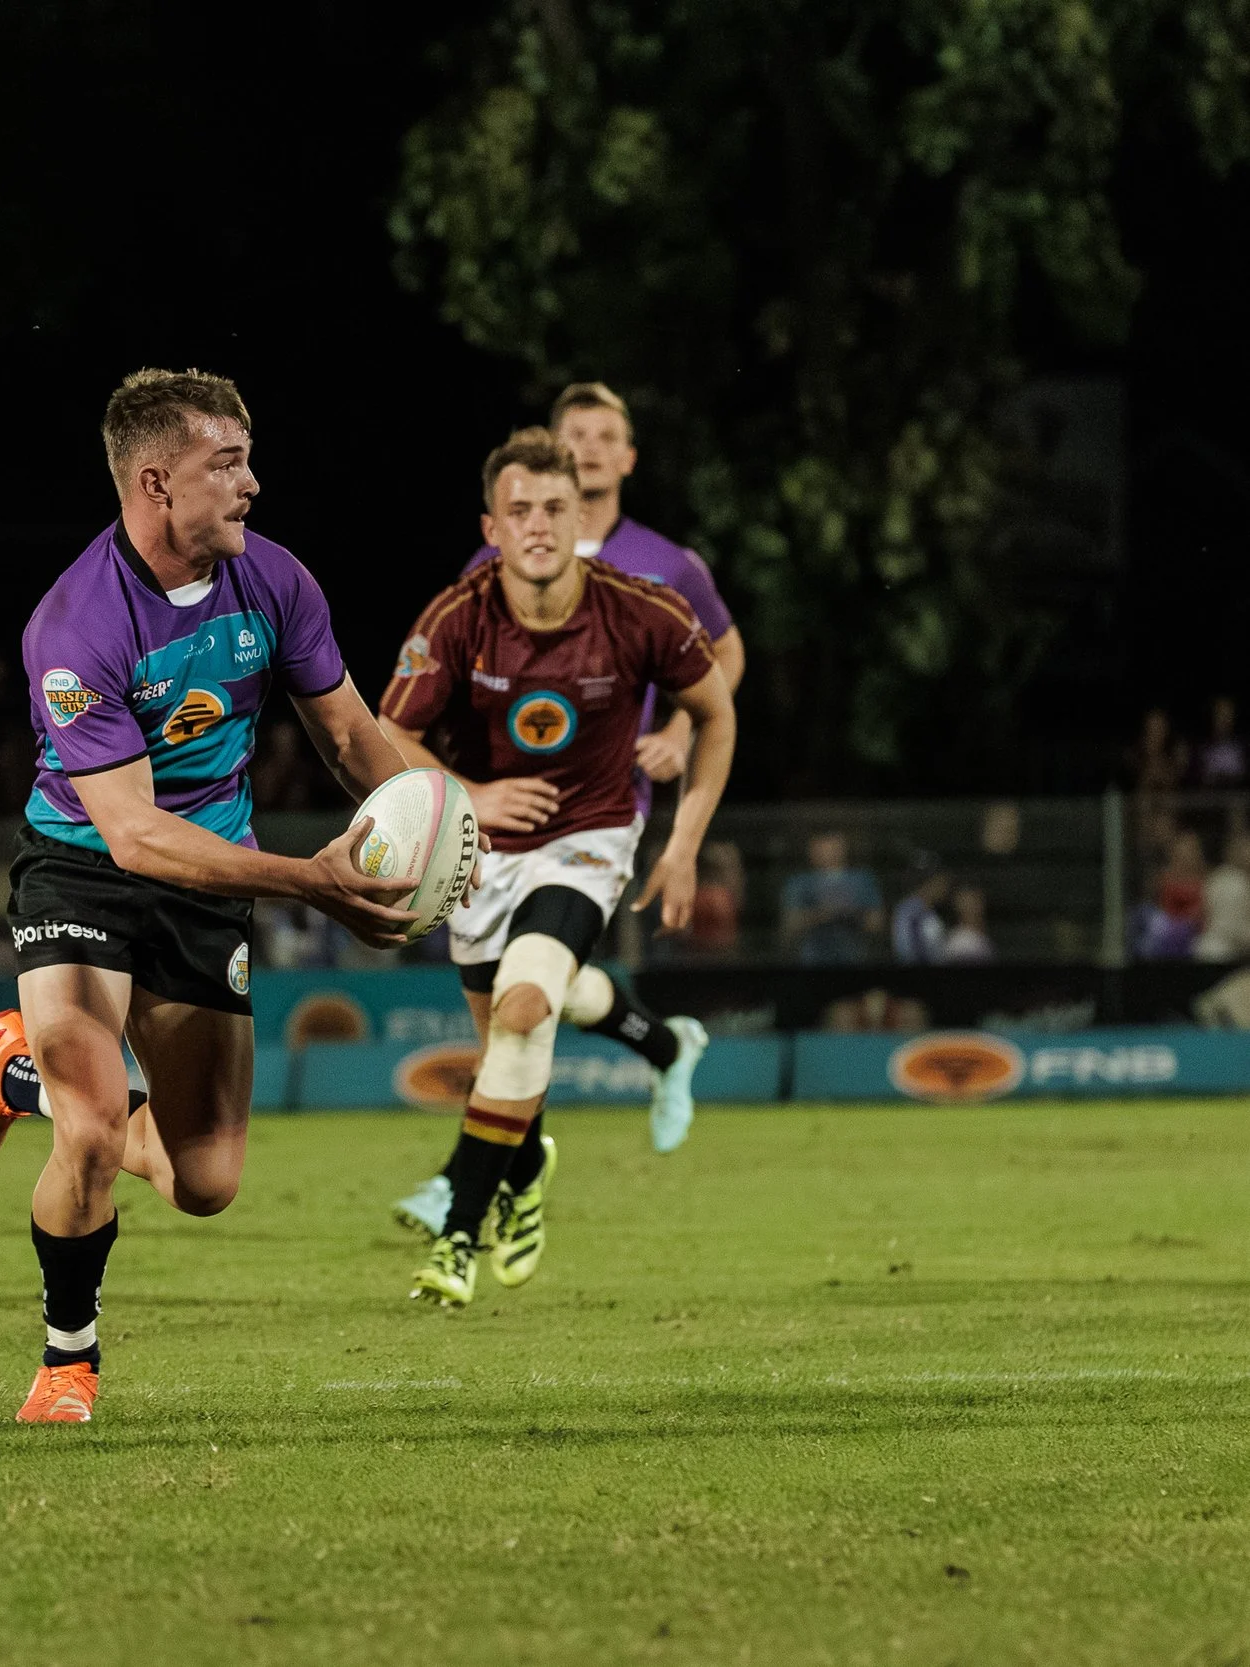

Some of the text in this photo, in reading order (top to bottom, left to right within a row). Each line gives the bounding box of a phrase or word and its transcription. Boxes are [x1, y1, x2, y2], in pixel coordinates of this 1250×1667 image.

[234, 647, 262, 663] NWU
[50, 678, 70, 687] FNB
[60, 702, 85, 713] CUP
[423, 813, 475, 934] GILBER
